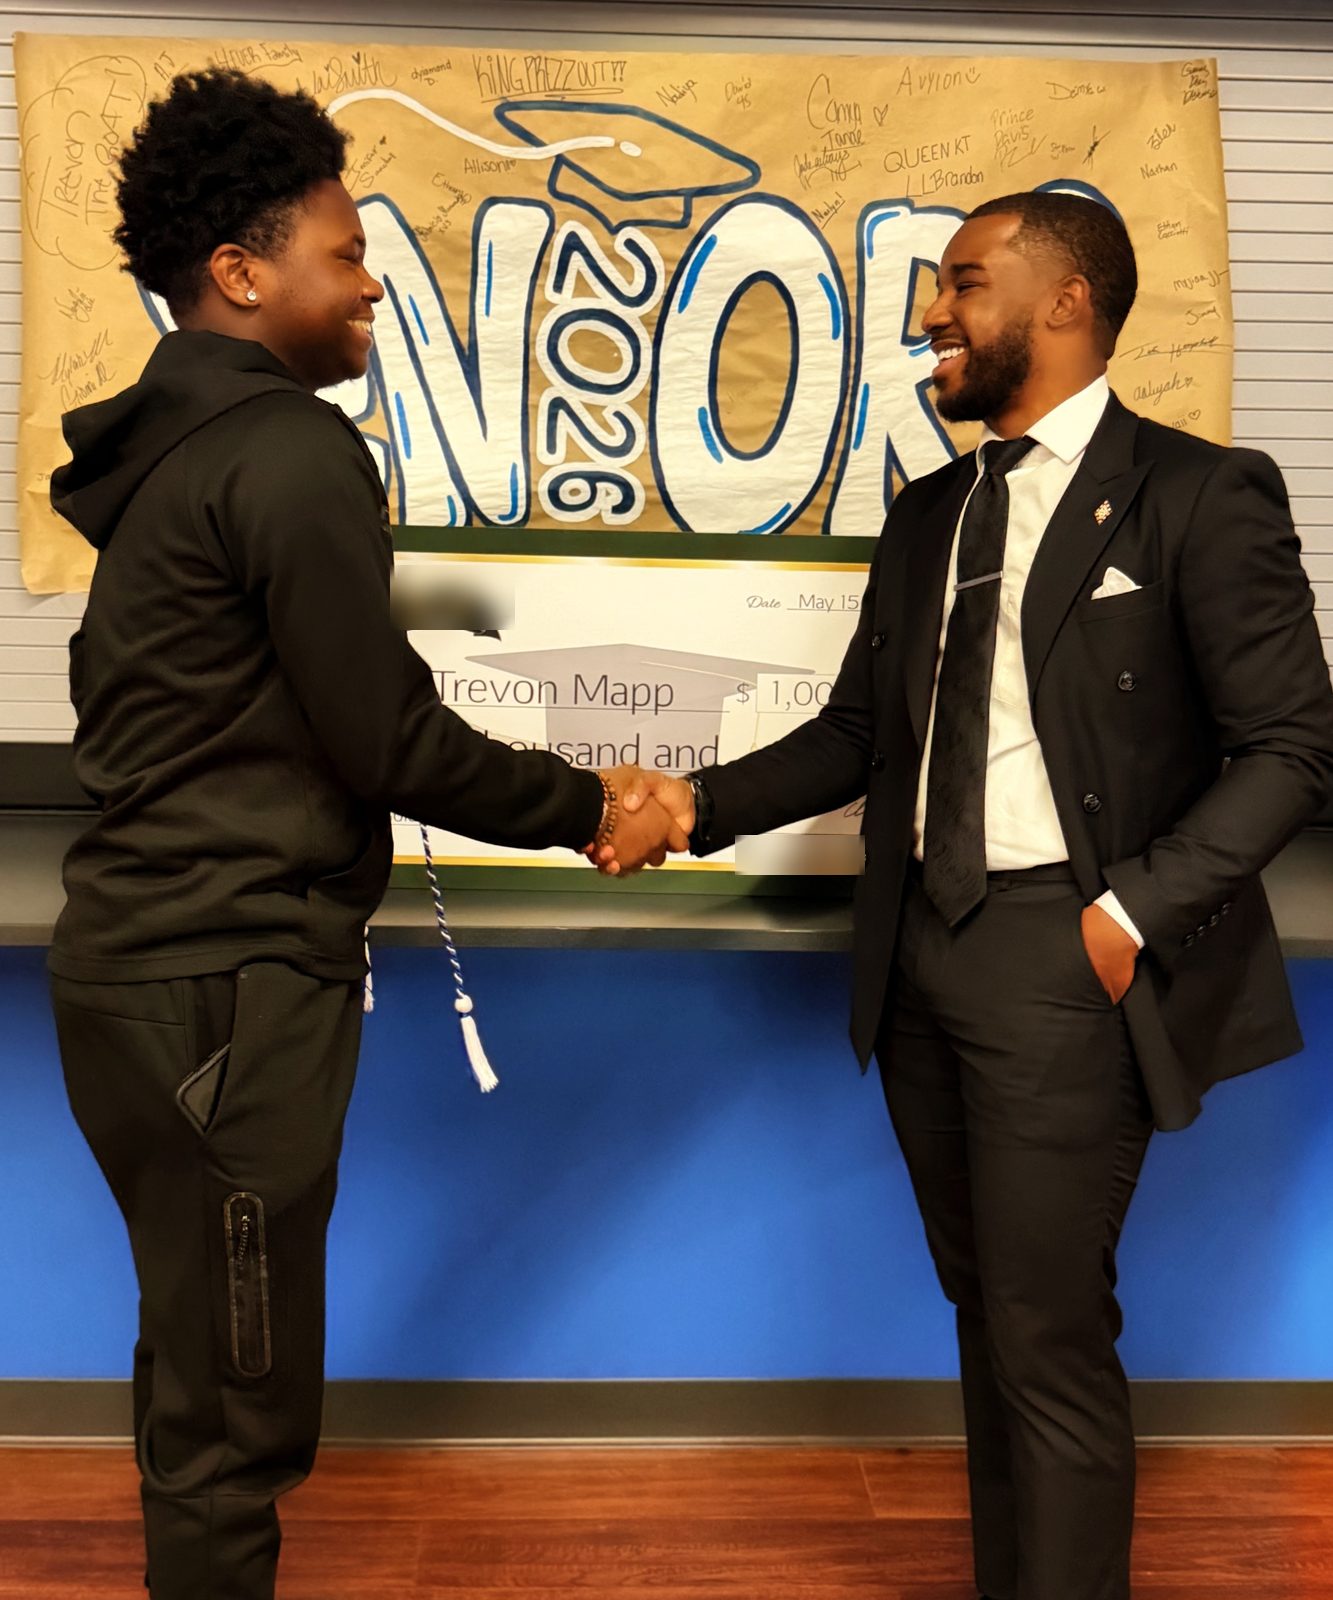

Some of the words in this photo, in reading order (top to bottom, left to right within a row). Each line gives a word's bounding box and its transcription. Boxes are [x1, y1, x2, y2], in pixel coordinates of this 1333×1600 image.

[746, 595, 781, 609] Date
[798, 593, 835, 613] May
[840, 594, 860, 611] 15
[432, 670, 557, 705] Trevon
[573, 673, 674, 716] Mapp
[772, 680, 833, 712] 1,00
[654, 735, 719, 770] and
